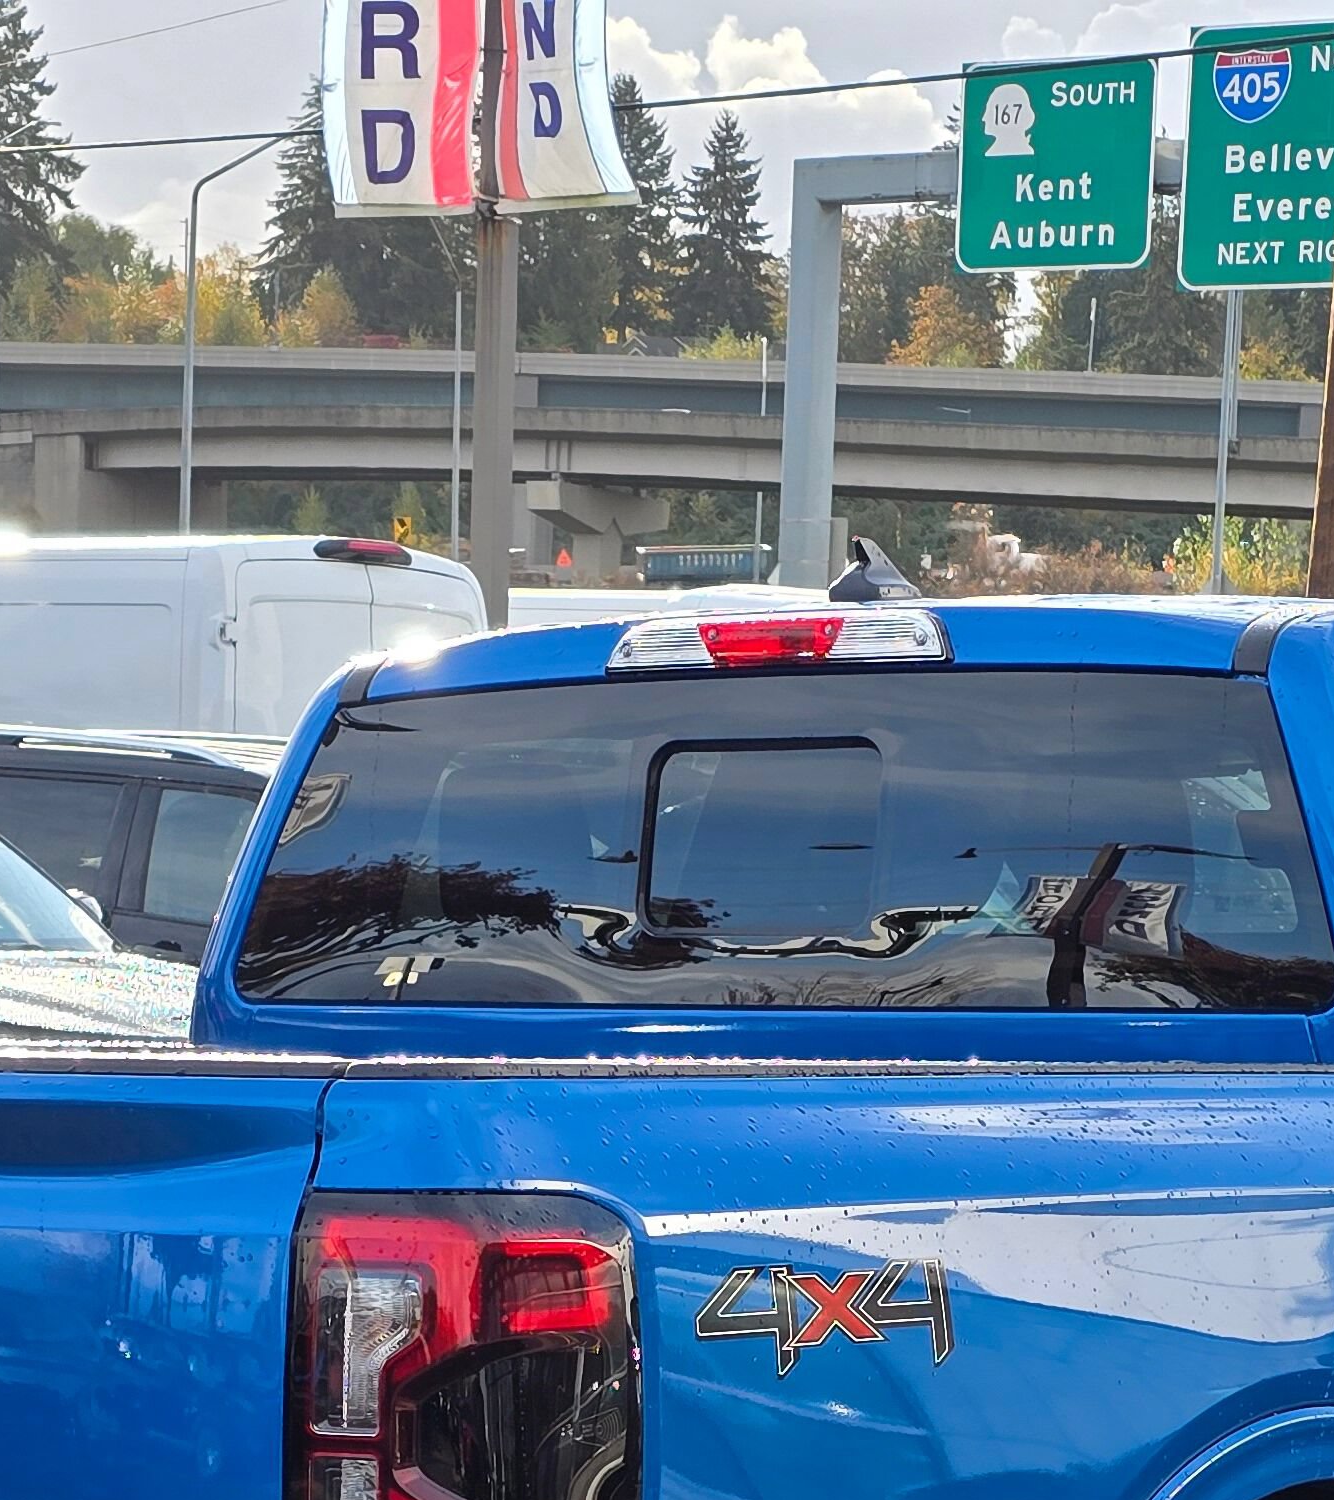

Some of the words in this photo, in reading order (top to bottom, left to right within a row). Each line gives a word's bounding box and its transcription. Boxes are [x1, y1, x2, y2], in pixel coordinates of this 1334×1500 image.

[1230, 53, 1275, 65] INTERSTATE
[1050, 80, 1136, 107] SOUTH
[1222, 71, 1281, 105] 405
[994, 103, 1023, 126] 167
[1015, 171, 1093, 203] Kent
[989, 219, 1116, 251] Auburn
[1217, 241, 1285, 266] NEXT
